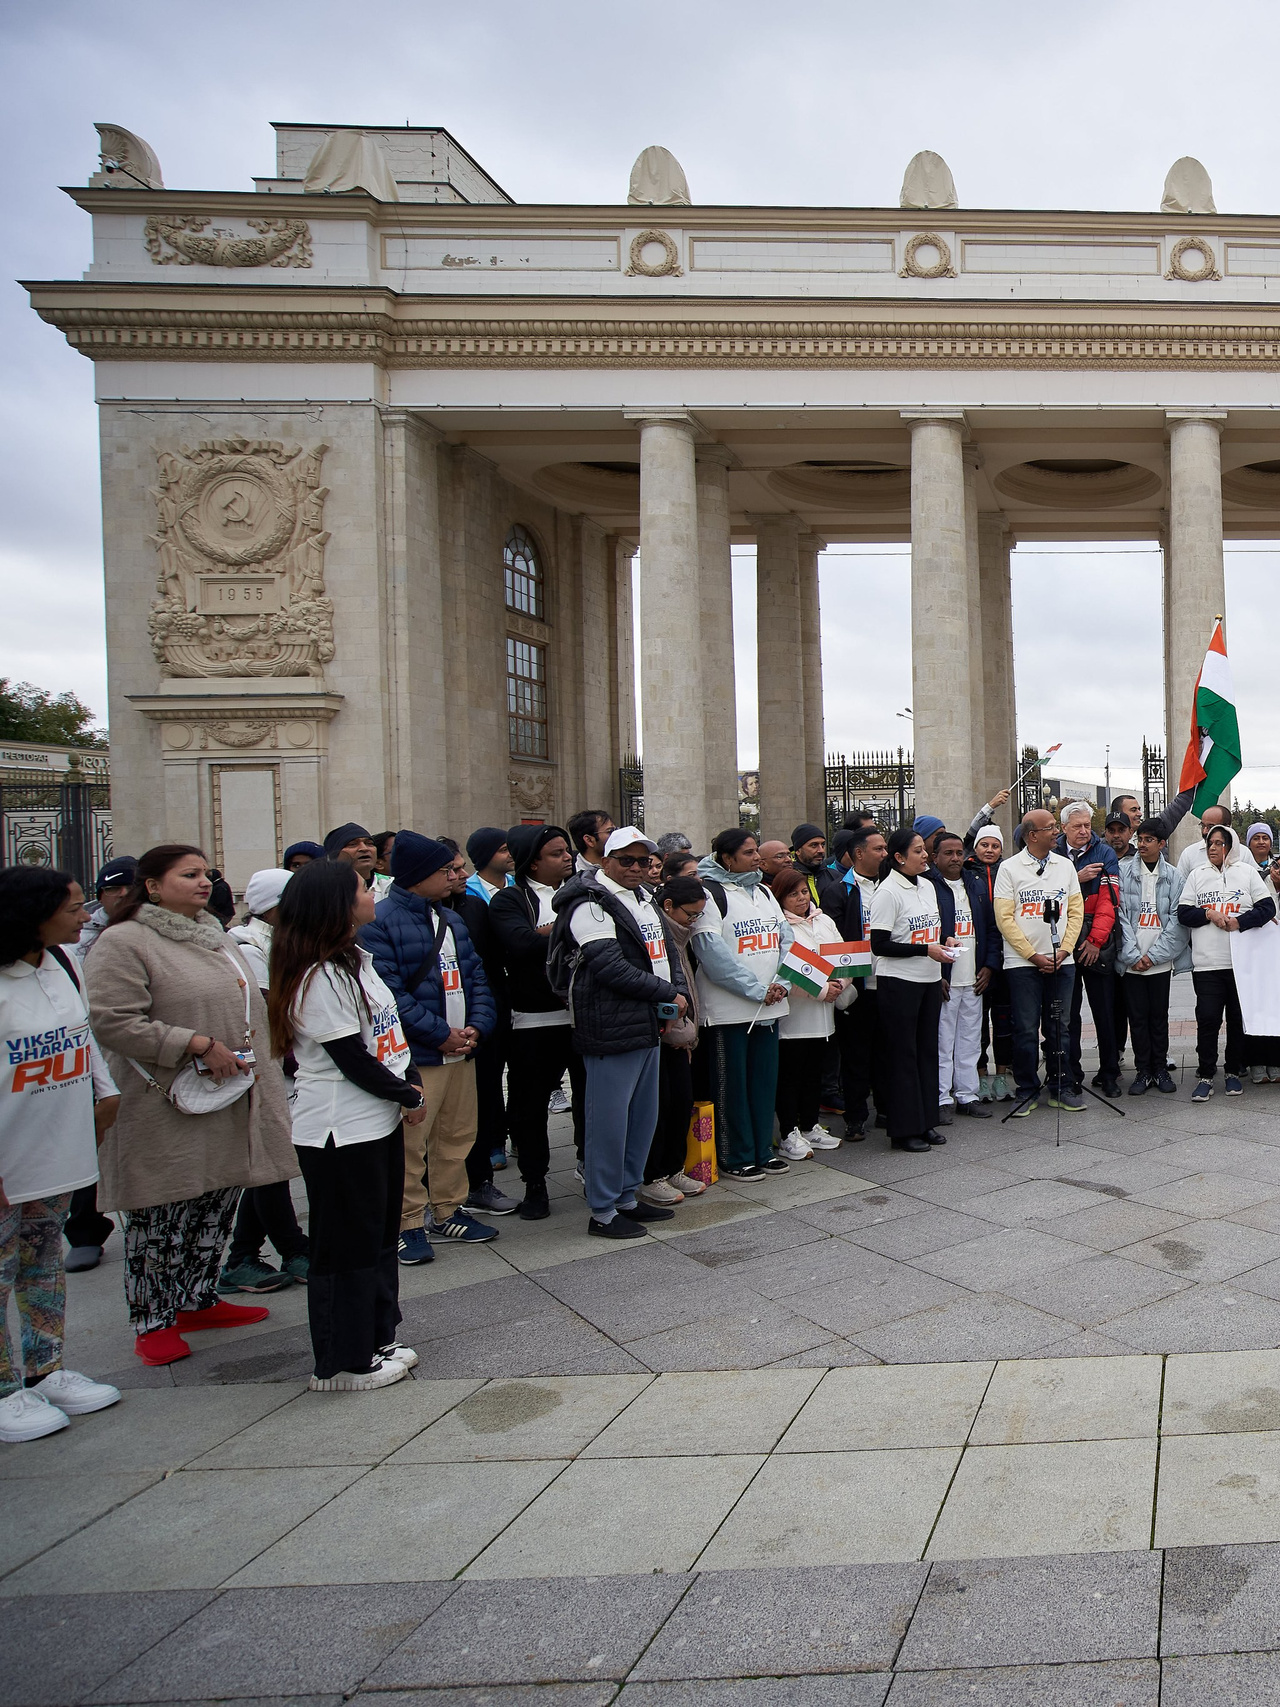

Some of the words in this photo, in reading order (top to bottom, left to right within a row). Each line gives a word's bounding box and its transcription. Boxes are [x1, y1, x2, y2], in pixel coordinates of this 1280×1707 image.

[218, 588, 263, 601] 1955
[1018, 889, 1044, 898] VIKSIT
[1196, 890, 1220, 900] VIKSIT
[732, 918, 762, 930] VIKSIT
[907, 913, 929, 925] VIKSIT
[1138, 913, 1161, 927] UN
[640, 922, 654, 933] SIT
[734, 925, 771, 938] BHARAT
[6, 1026, 67, 1052] VIKSIT
[9, 1034, 82, 1065] BHARAT
[46, 1084, 58, 1092] TO
[59, 1078, 79, 1089] SERVE
